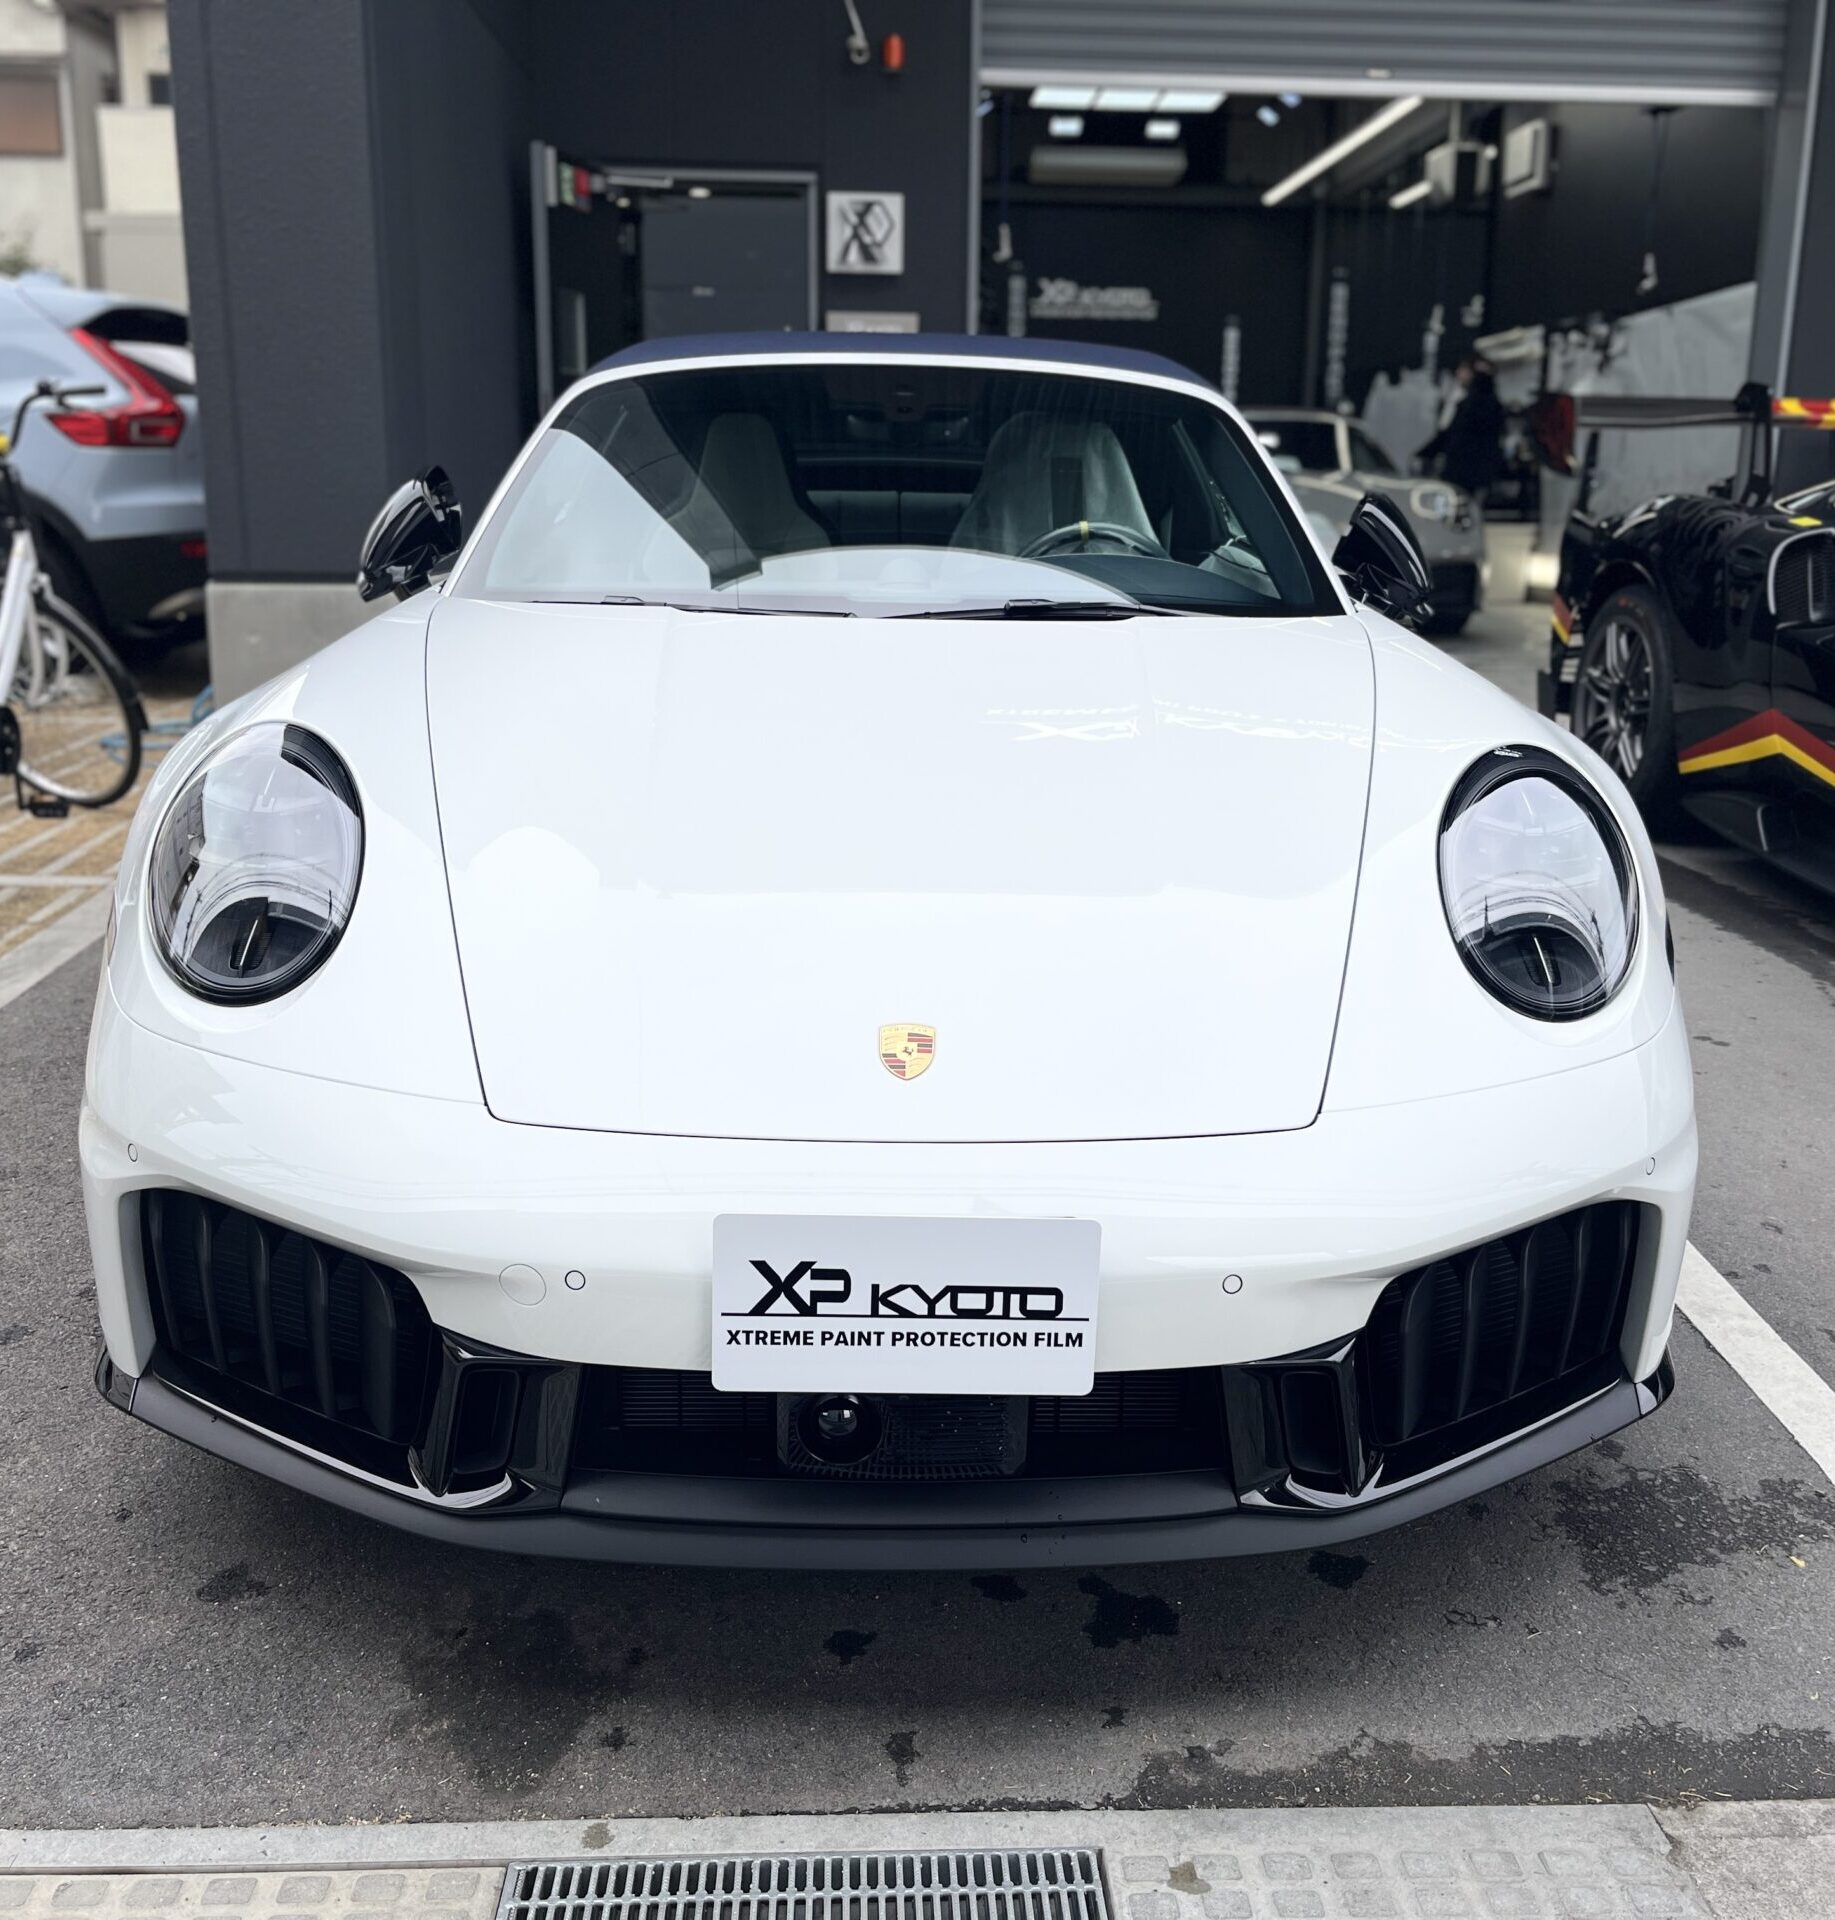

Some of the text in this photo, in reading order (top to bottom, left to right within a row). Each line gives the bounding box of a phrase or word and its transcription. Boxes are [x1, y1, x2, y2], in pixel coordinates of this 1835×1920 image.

[748, 1259, 1064, 1318] XP KYOTO
[726, 1329, 1084, 1348] XTREME PAINT PROTECTION FILM
